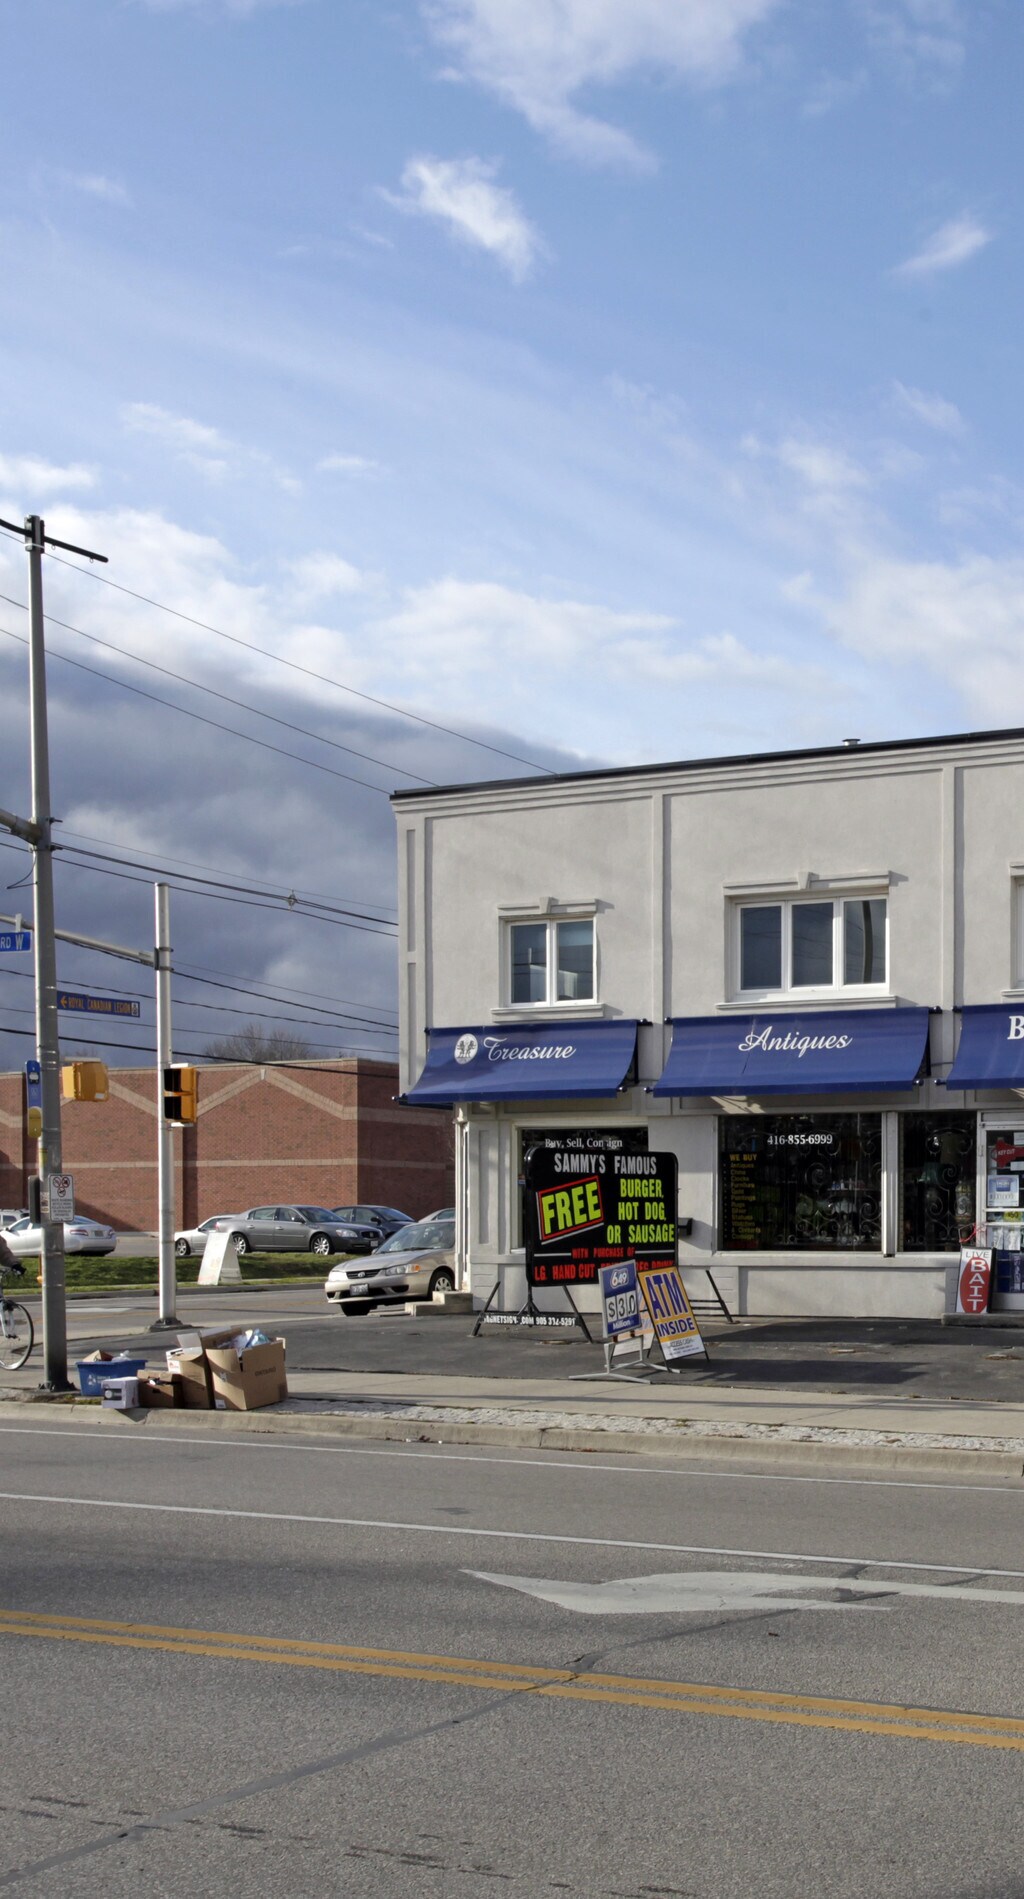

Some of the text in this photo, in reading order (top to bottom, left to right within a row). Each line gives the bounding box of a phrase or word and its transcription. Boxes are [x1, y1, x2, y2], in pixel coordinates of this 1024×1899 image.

[15, 934, 24, 950] W
[483, 1036, 576, 1062] Treasure
[738, 1025, 853, 1058] Antiques
[567, 1138, 584, 1149] Sell,
[767, 1134, 833, 1147] 416-855-6999
[554, 1153, 657, 1175] SAMMY'S FAMOUS
[620, 1178, 664, 1199] BURGER,
[541, 1181, 602, 1235] FREE
[618, 1202, 639, 1221] HOT
[607, 1224, 675, 1244] OR SAUSAGE
[572, 1247, 635, 1259] WITH PURCHASE OF
[966, 1250, 990, 1259] LIVE
[552, 1263, 576, 1279] HAND
[578, 1263, 596, 1279] CUT
[967, 1259, 987, 1311] BAIT
[645, 1272, 688, 1319] ATM
[612, 1319, 631, 1331] Million
[656, 1317, 695, 1337] INSIDE
